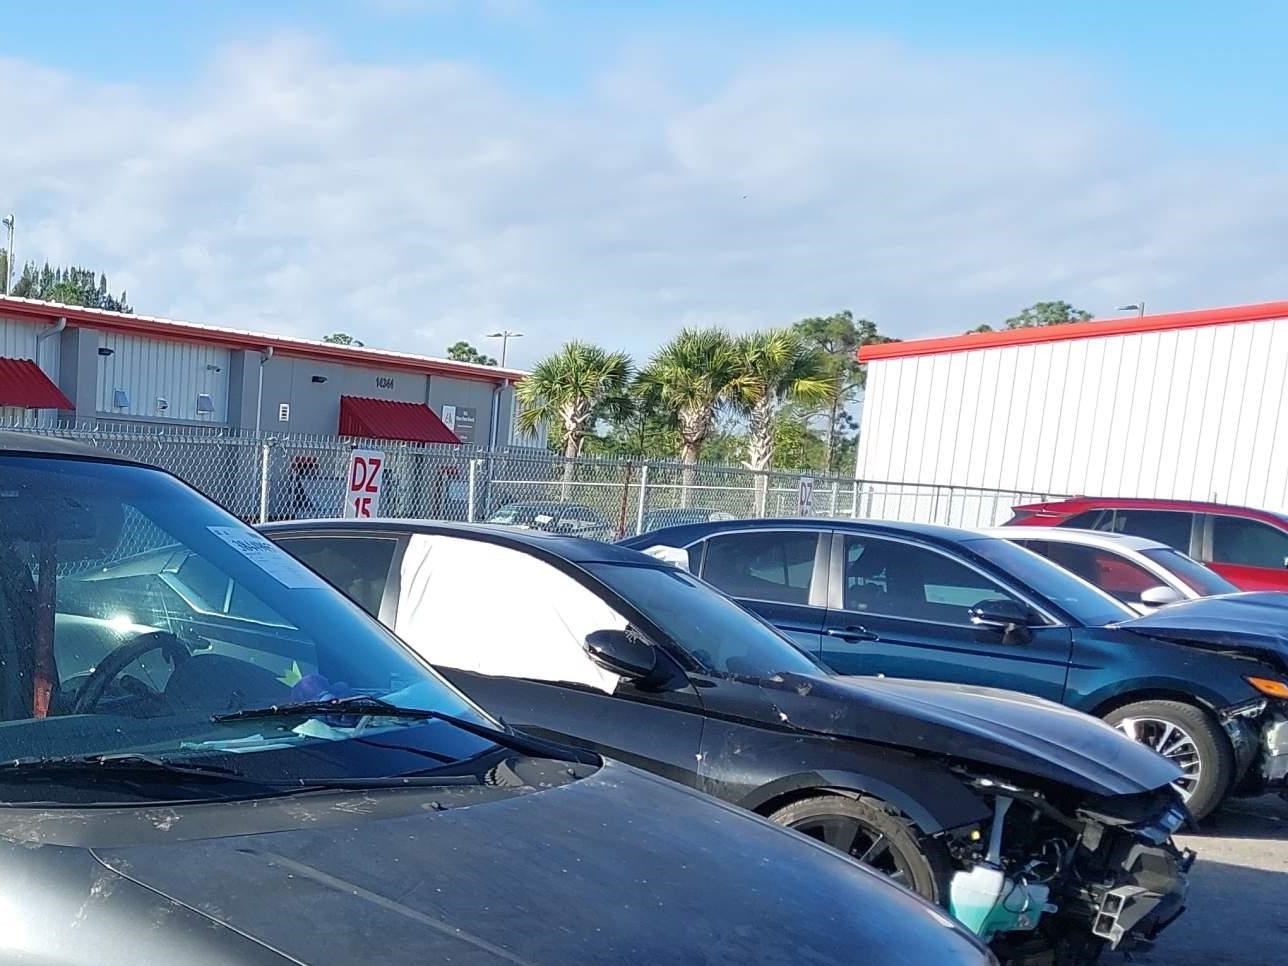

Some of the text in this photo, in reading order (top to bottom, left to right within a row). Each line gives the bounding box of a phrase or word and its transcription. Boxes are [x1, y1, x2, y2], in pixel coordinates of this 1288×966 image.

[351, 456, 382, 493] DZ
[800, 481, 813, 505] DZ
[354, 497, 372, 518] 15
